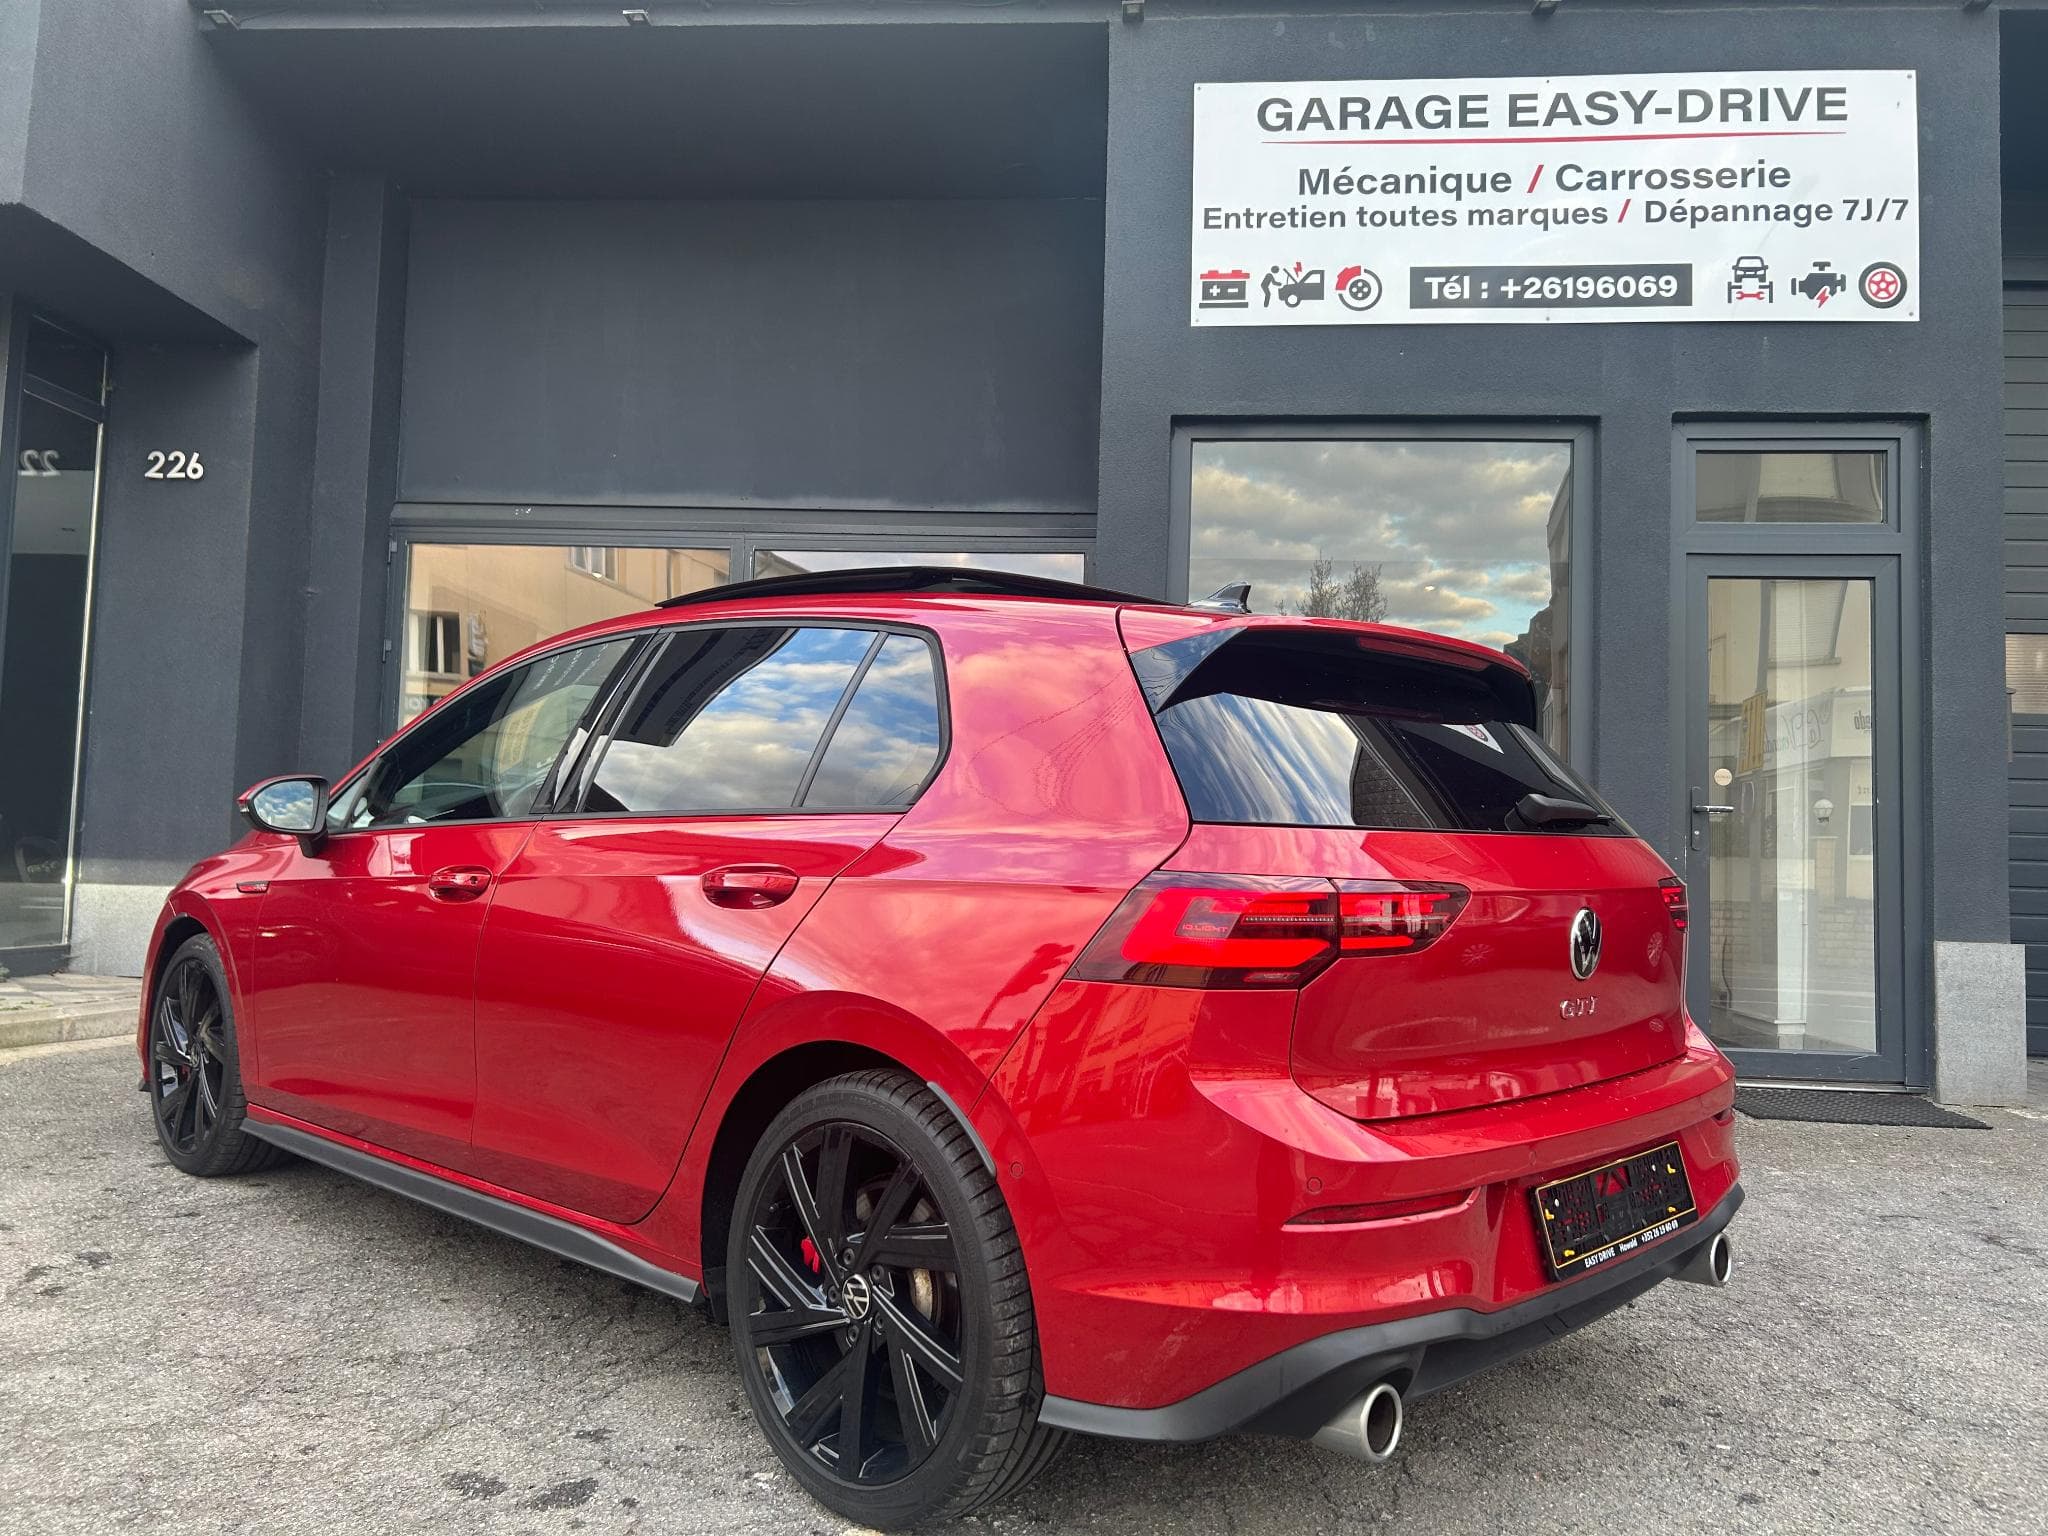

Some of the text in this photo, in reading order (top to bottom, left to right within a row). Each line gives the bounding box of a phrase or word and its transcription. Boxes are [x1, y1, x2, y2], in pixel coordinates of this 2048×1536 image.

[1256, 86, 1848, 133] GARAGE EASY-DRIVE
[1298, 165, 1512, 202] Mécanique
[1555, 158, 1791, 192] Carrosserie
[1203, 204, 1346, 230] Entretien
[1356, 206, 1458, 228] toutes
[1467, 206, 1609, 232] marques
[1645, 198, 1834, 230] Dépannage
[1842, 197, 1909, 223] 7J/7
[1423, 275, 1470, 300] Tél
[1500, 275, 1678, 300] +26196069
[144, 450, 204, 480] 226
[1560, 996, 1597, 1018] GTI
[1584, 1255, 1599, 1268] EASY
[1598, 1247, 1616, 1262] DRIVE
